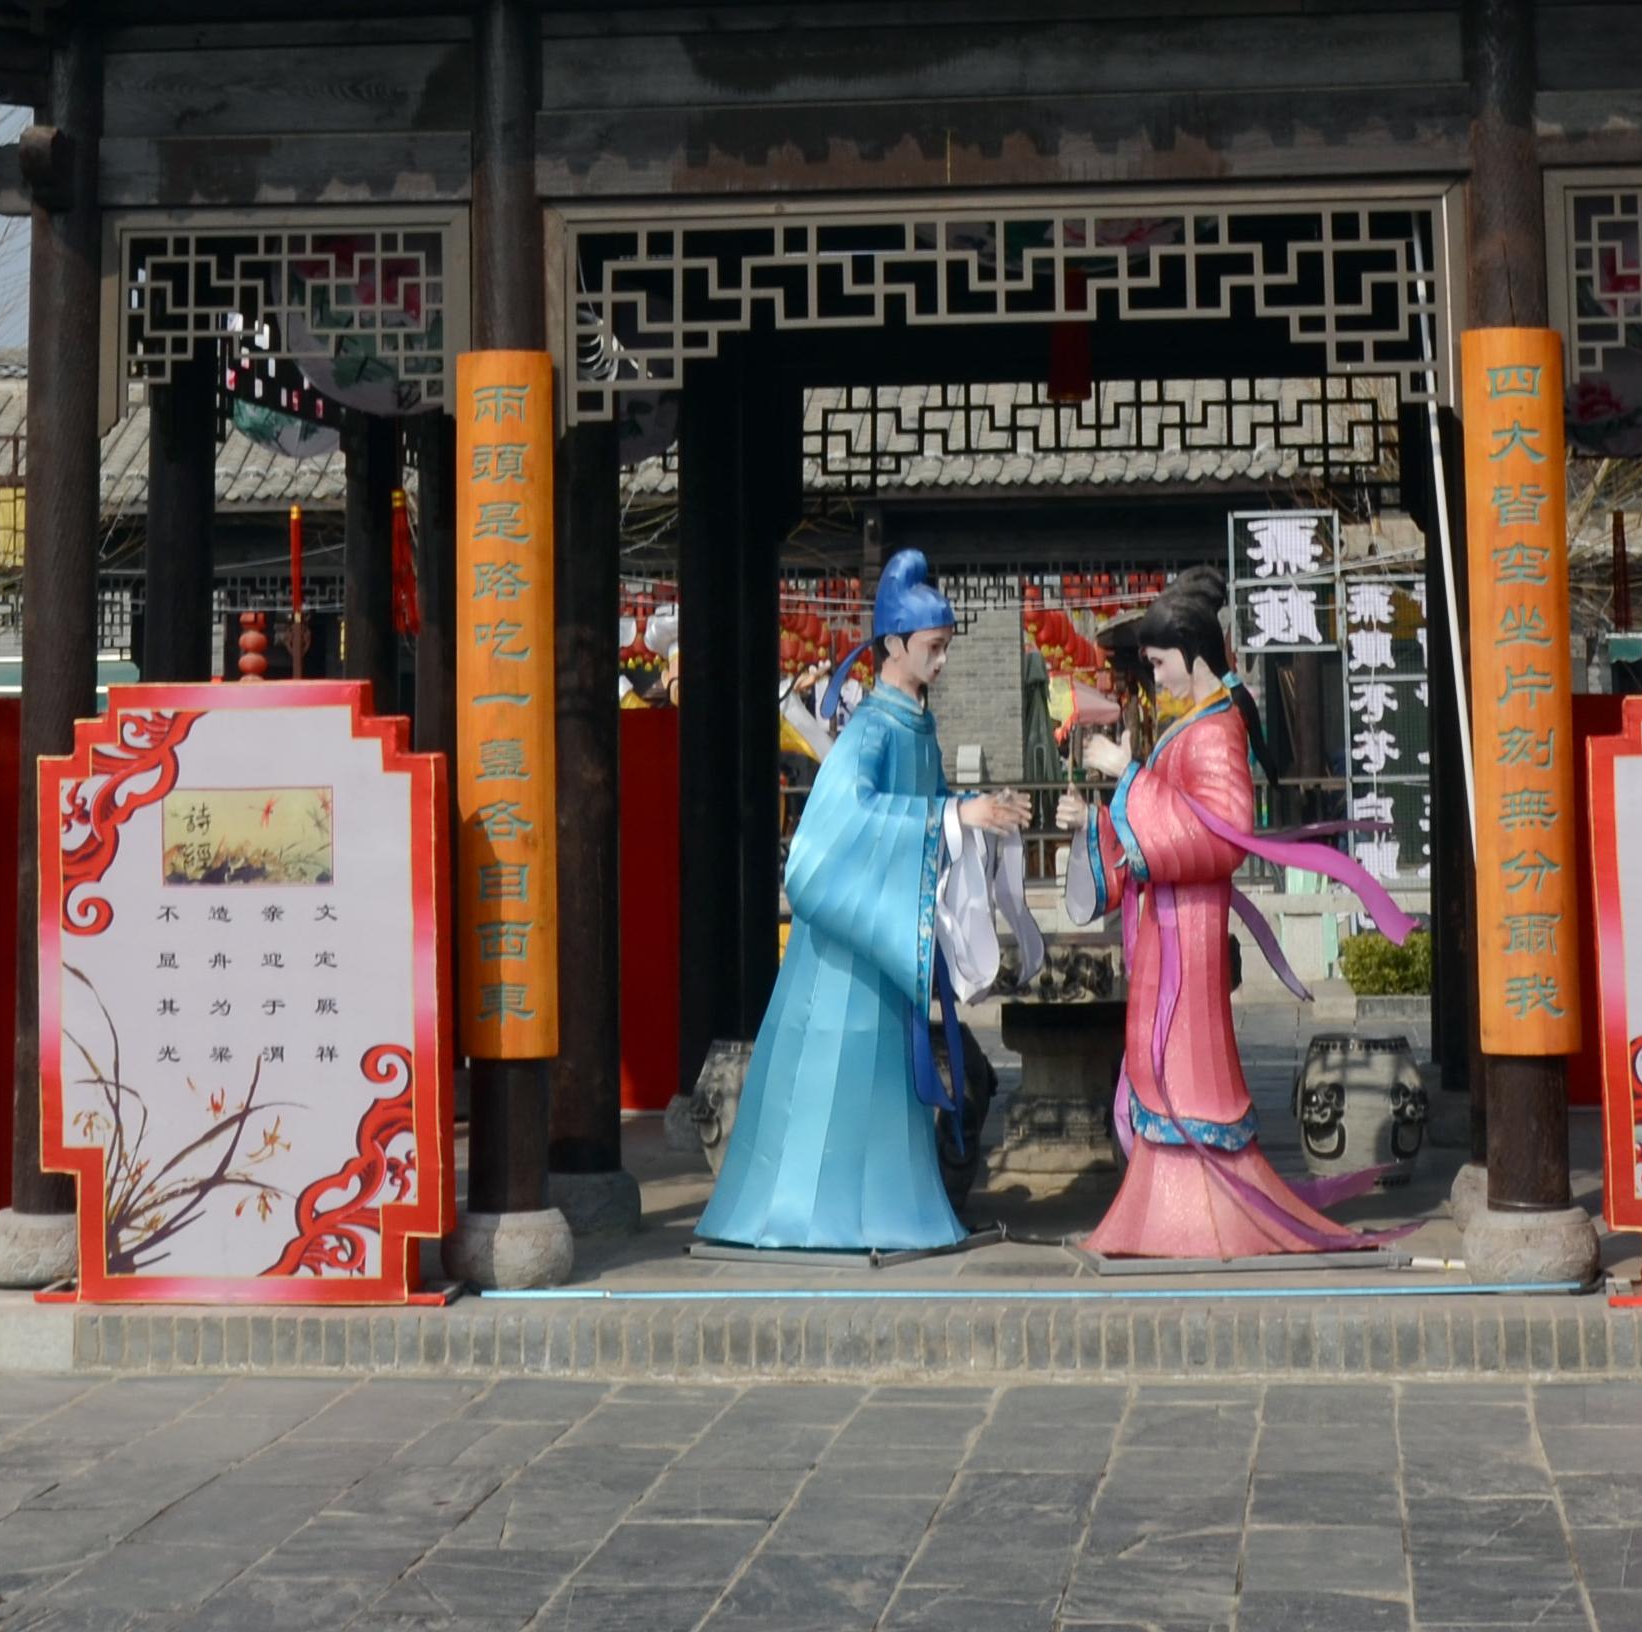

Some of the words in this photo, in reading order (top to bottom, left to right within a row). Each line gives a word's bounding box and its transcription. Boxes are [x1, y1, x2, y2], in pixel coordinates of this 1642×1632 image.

[470, 382, 535, 1026] 兩頭是路吃一盞各自西東
[1485, 364, 1566, 1020] 四大皆空坐片刻無分爾我
[156, 904, 181, 1063] 不显其光
[208, 904, 233, 1063] 造舟为梁
[261, 903, 286, 1064] 亲迎于渭
[314, 903, 339, 1063] 文定厥祥
